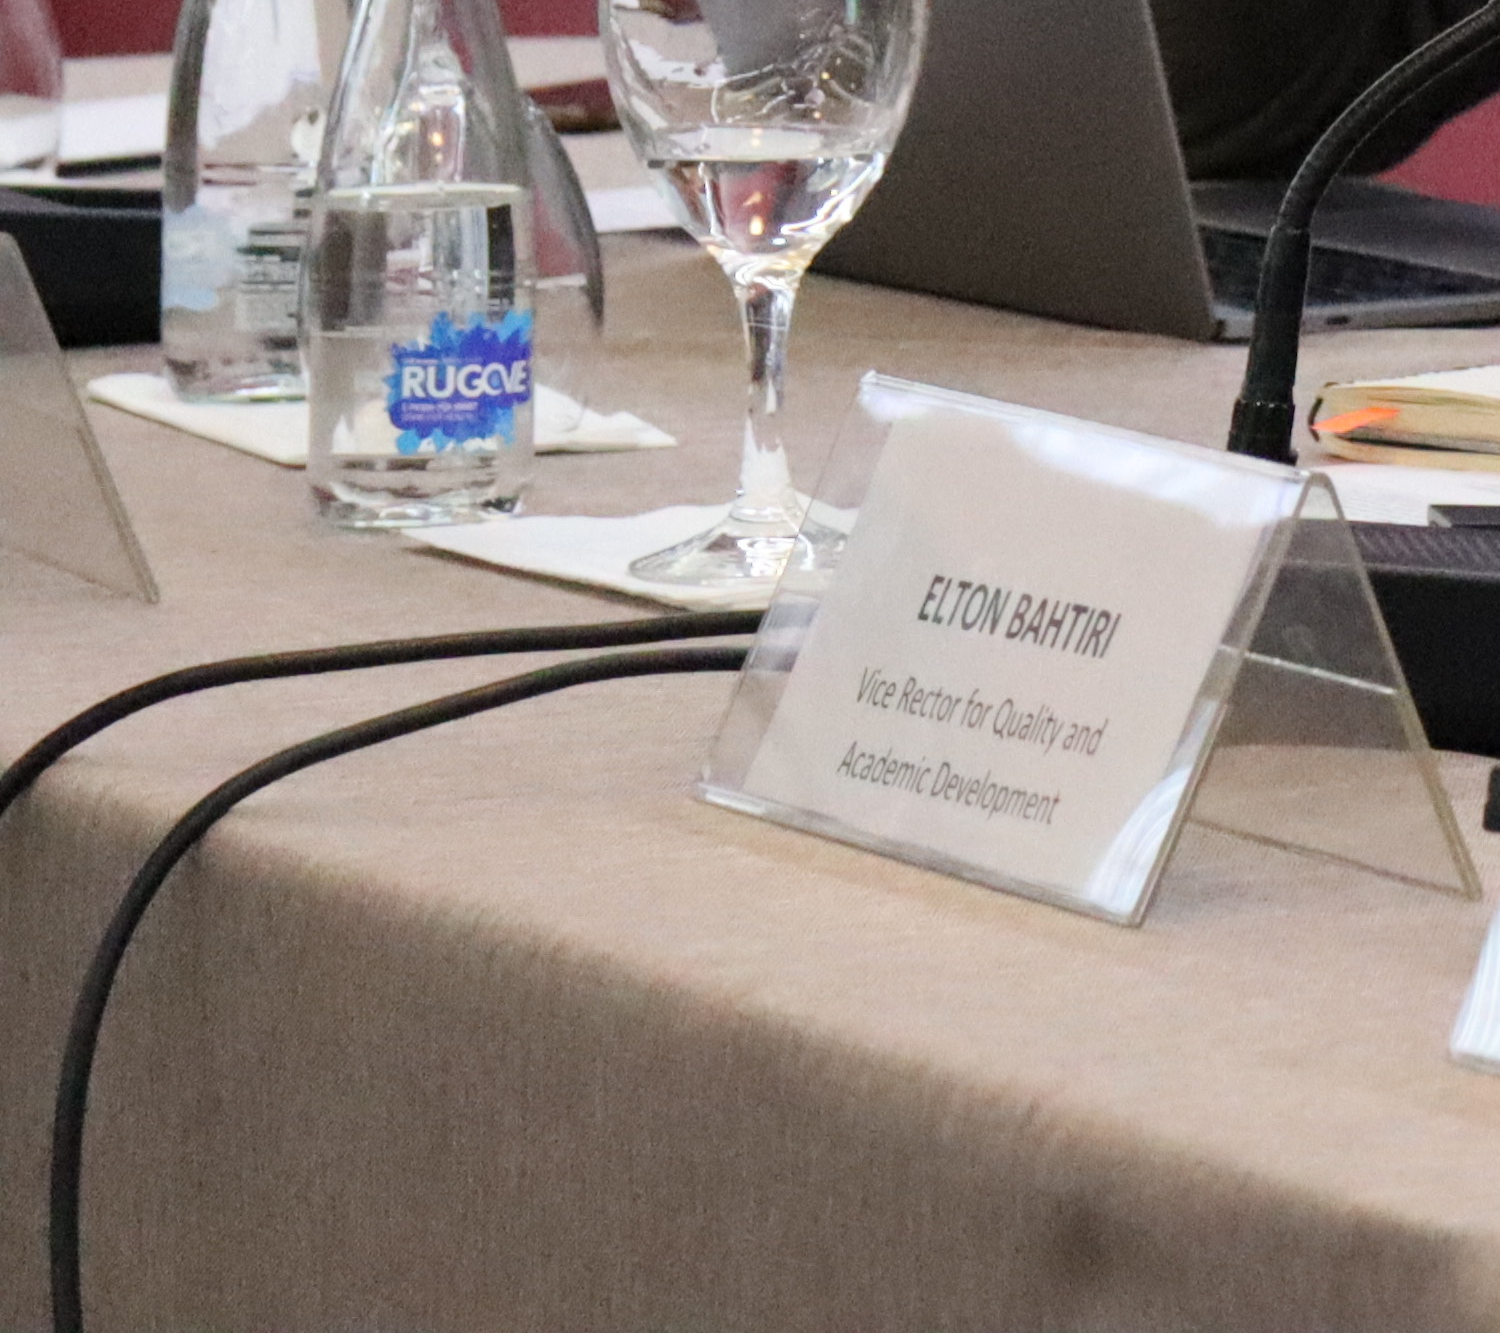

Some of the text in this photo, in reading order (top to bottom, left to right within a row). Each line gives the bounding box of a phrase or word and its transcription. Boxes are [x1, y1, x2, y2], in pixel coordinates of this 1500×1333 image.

[917, 574, 1121, 658] ELTON BAHTIRI
[856, 667, 1108, 756] Vice Rector for Quality and
[837, 741, 1060, 824] Academic Development
